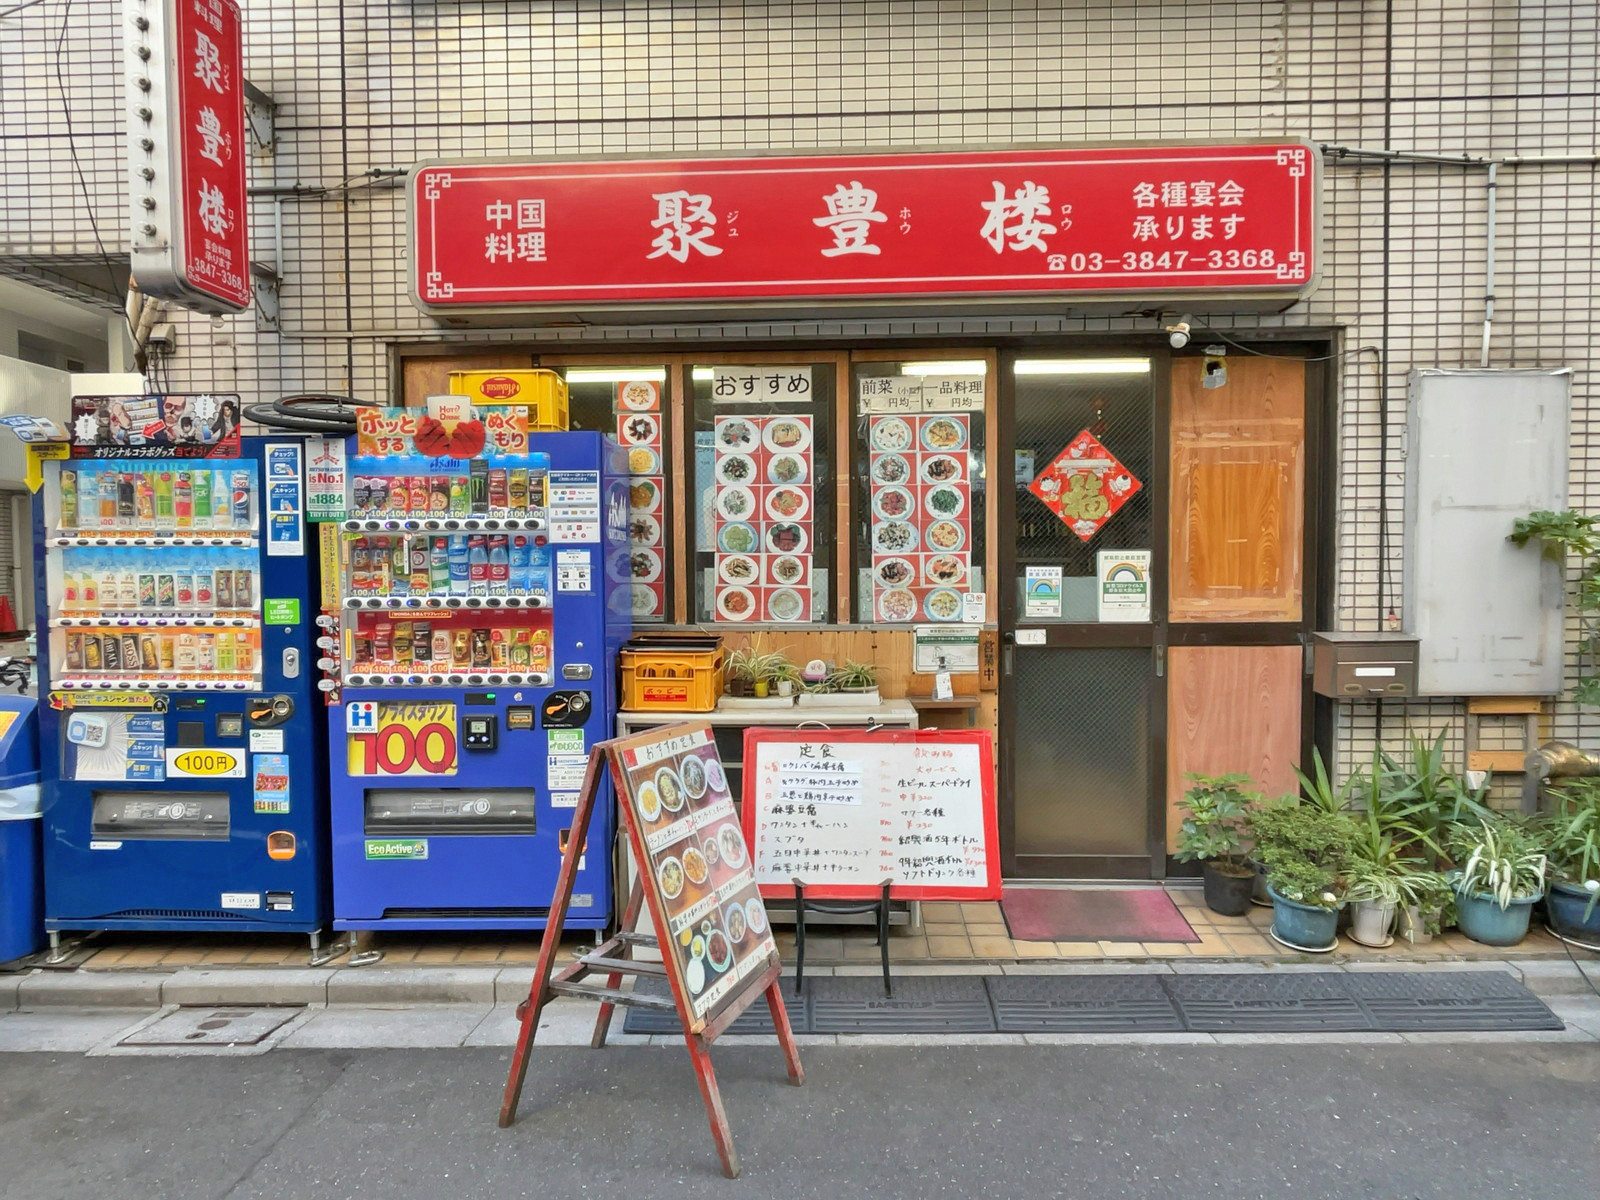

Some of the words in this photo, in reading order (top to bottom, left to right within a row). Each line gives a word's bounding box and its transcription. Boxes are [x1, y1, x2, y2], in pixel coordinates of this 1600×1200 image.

[1133, 180, 1245, 208] 各種宴会
[485, 199, 546, 230] 中国
[899, 207, 912, 235] ホウ
[1061, 204, 1073, 231] ロウ
[727, 210, 739, 237] ジュ
[1133, 214, 1245, 242] 承ります
[485, 233, 547, 263] 料理
[1070, 249, 1276, 272] 03-3847-3368
[194, 257, 242, 290] 3847-3368
[715, 374, 809, 396] おすすめ
[862, 379, 892, 395] 前菜
[924, 381, 982, 394] 一品料理
[888, 398, 919, 407] 円均一
[951, 398, 982, 407] 円均一
[361, 411, 416, 435] ホッと
[487, 414, 517, 431] ぬく
[377, 436, 404, 452] する
[495, 432, 524, 448] もり
[318, 473, 343, 483] No.1
[315, 494, 343, 504] 1884
[799, 743, 836, 758] 定食
[184, 756, 227, 770] 100円
[929, 778, 971, 788] スーパードライ
[771, 803, 817, 817] 麻婆豆腐
